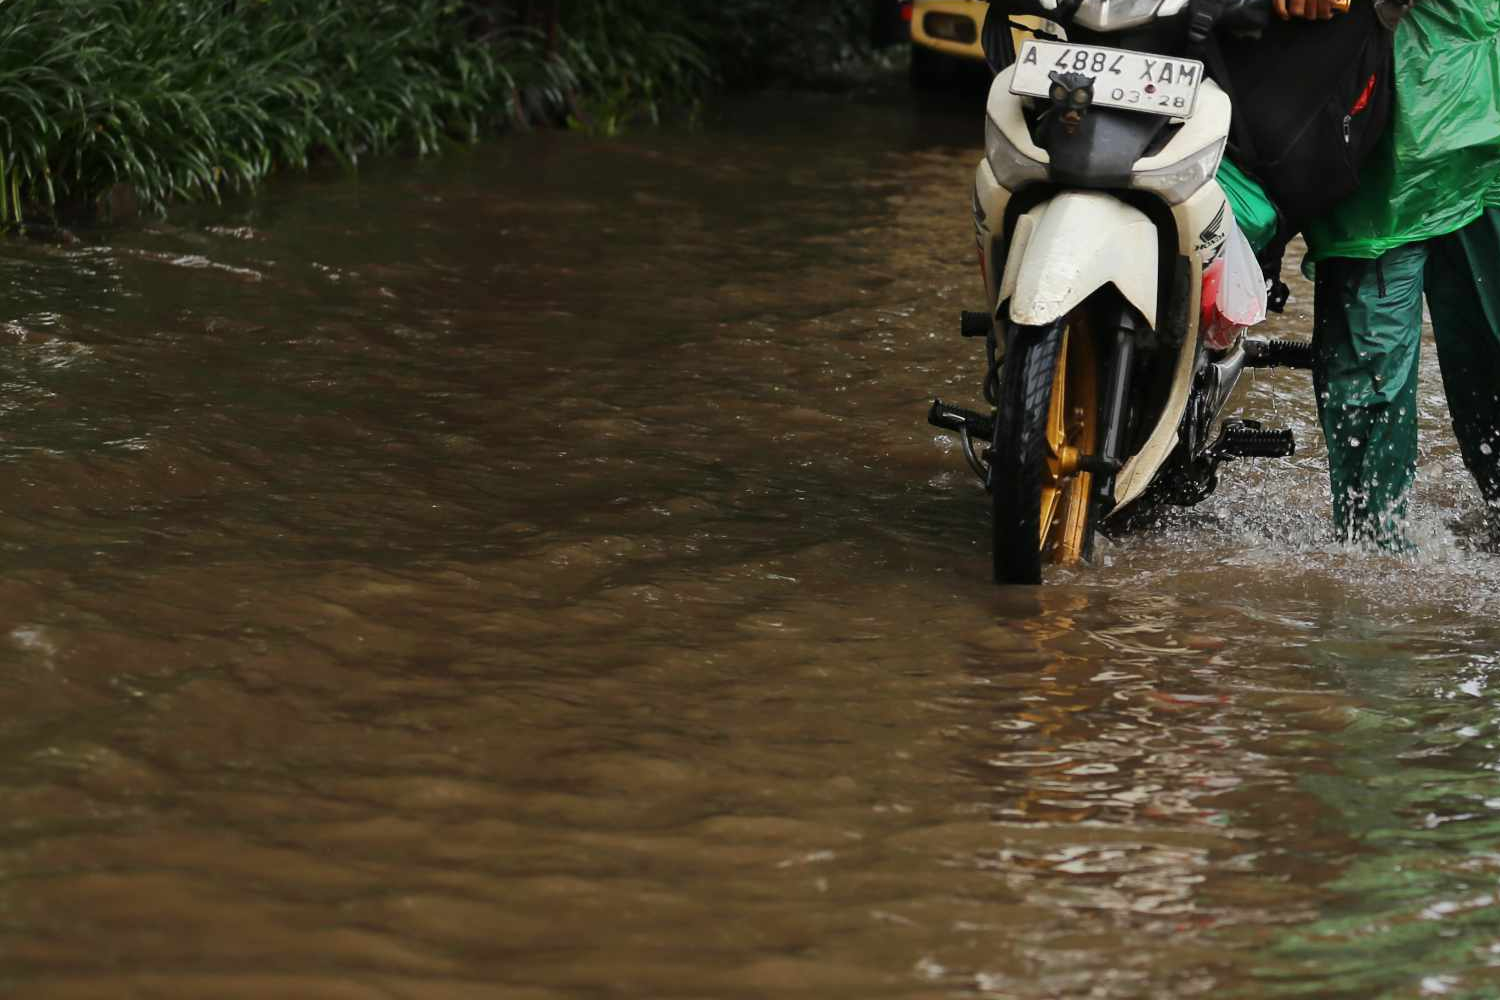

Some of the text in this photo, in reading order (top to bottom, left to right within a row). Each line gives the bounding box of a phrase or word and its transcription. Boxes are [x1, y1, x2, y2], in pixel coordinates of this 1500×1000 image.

[1023, 46, 1196, 86] A 4884 XAM
